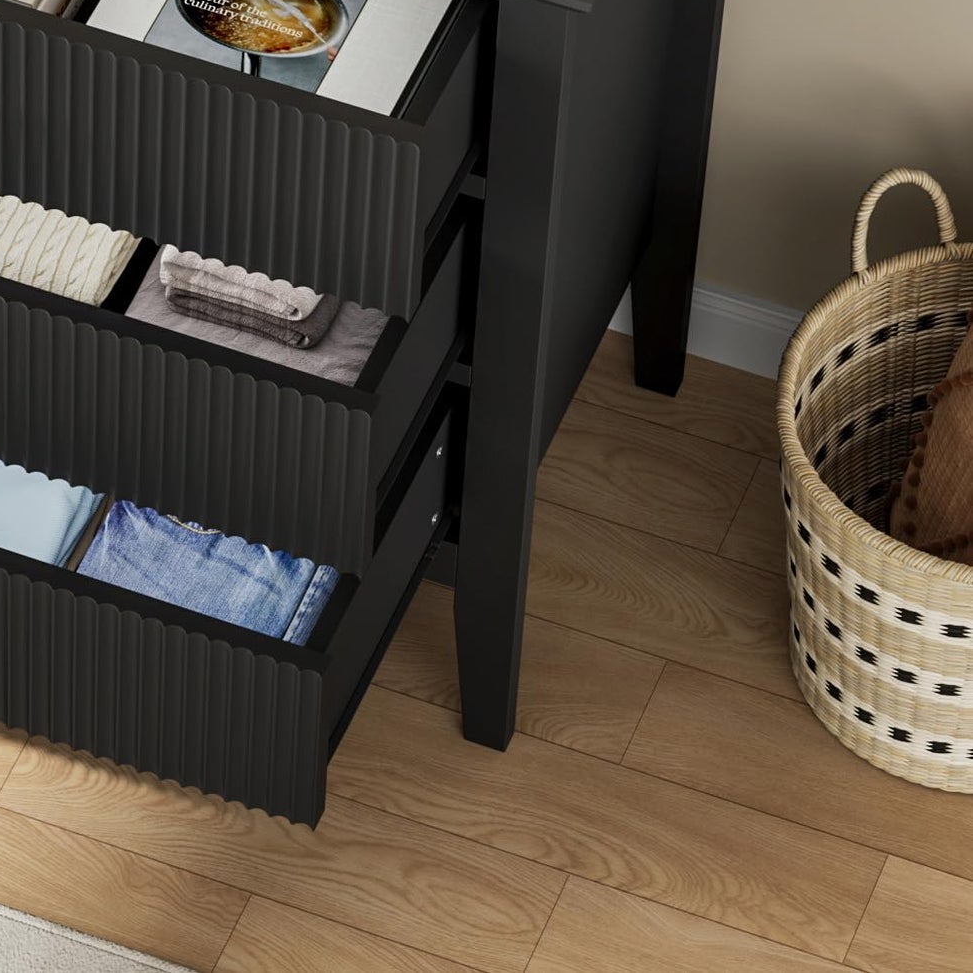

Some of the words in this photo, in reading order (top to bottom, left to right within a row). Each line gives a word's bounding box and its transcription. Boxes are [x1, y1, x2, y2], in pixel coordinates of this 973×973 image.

[230, 3, 248, 12] of
[246, 5, 268, 18] the
[240, 15, 304, 38] traditions
